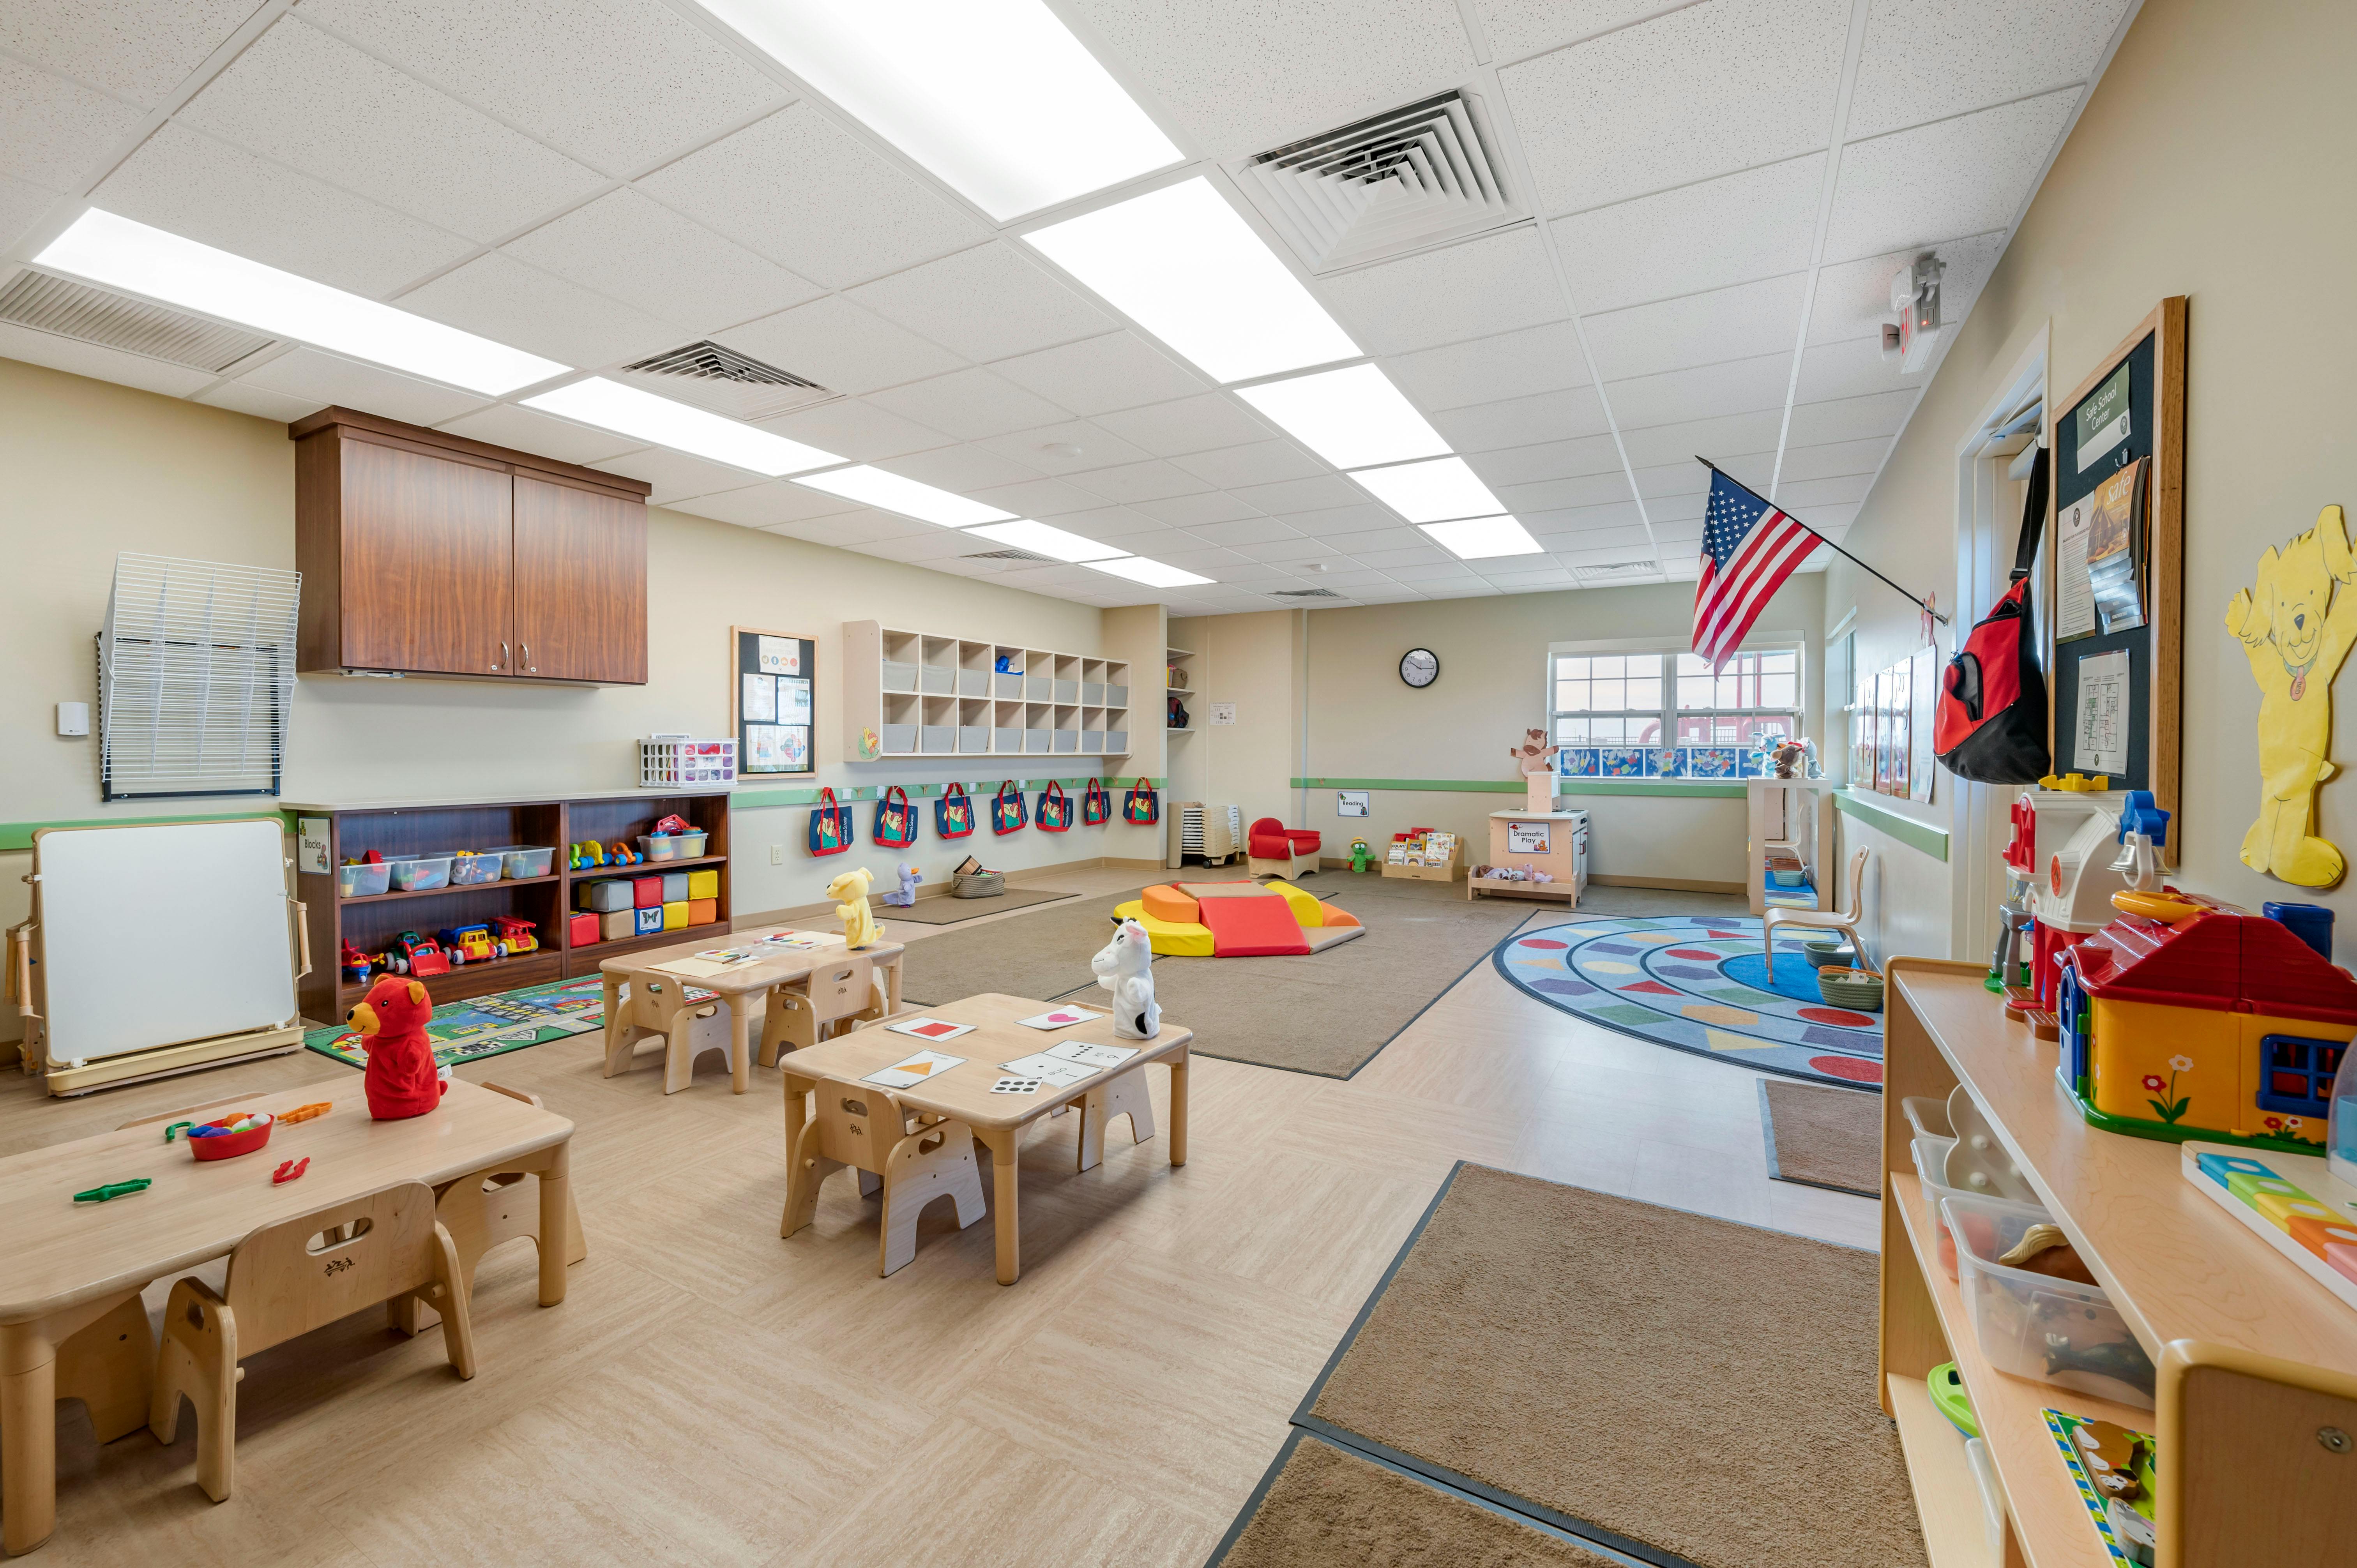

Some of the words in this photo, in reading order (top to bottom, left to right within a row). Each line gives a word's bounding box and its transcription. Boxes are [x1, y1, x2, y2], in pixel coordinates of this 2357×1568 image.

[2086, 402, 2097, 422] Safe
[2098, 382, 2117, 411] School
[2092, 408, 2110, 431] Center
[2107, 470, 2131, 505] safe
[305, 839, 321, 849] Blocks
